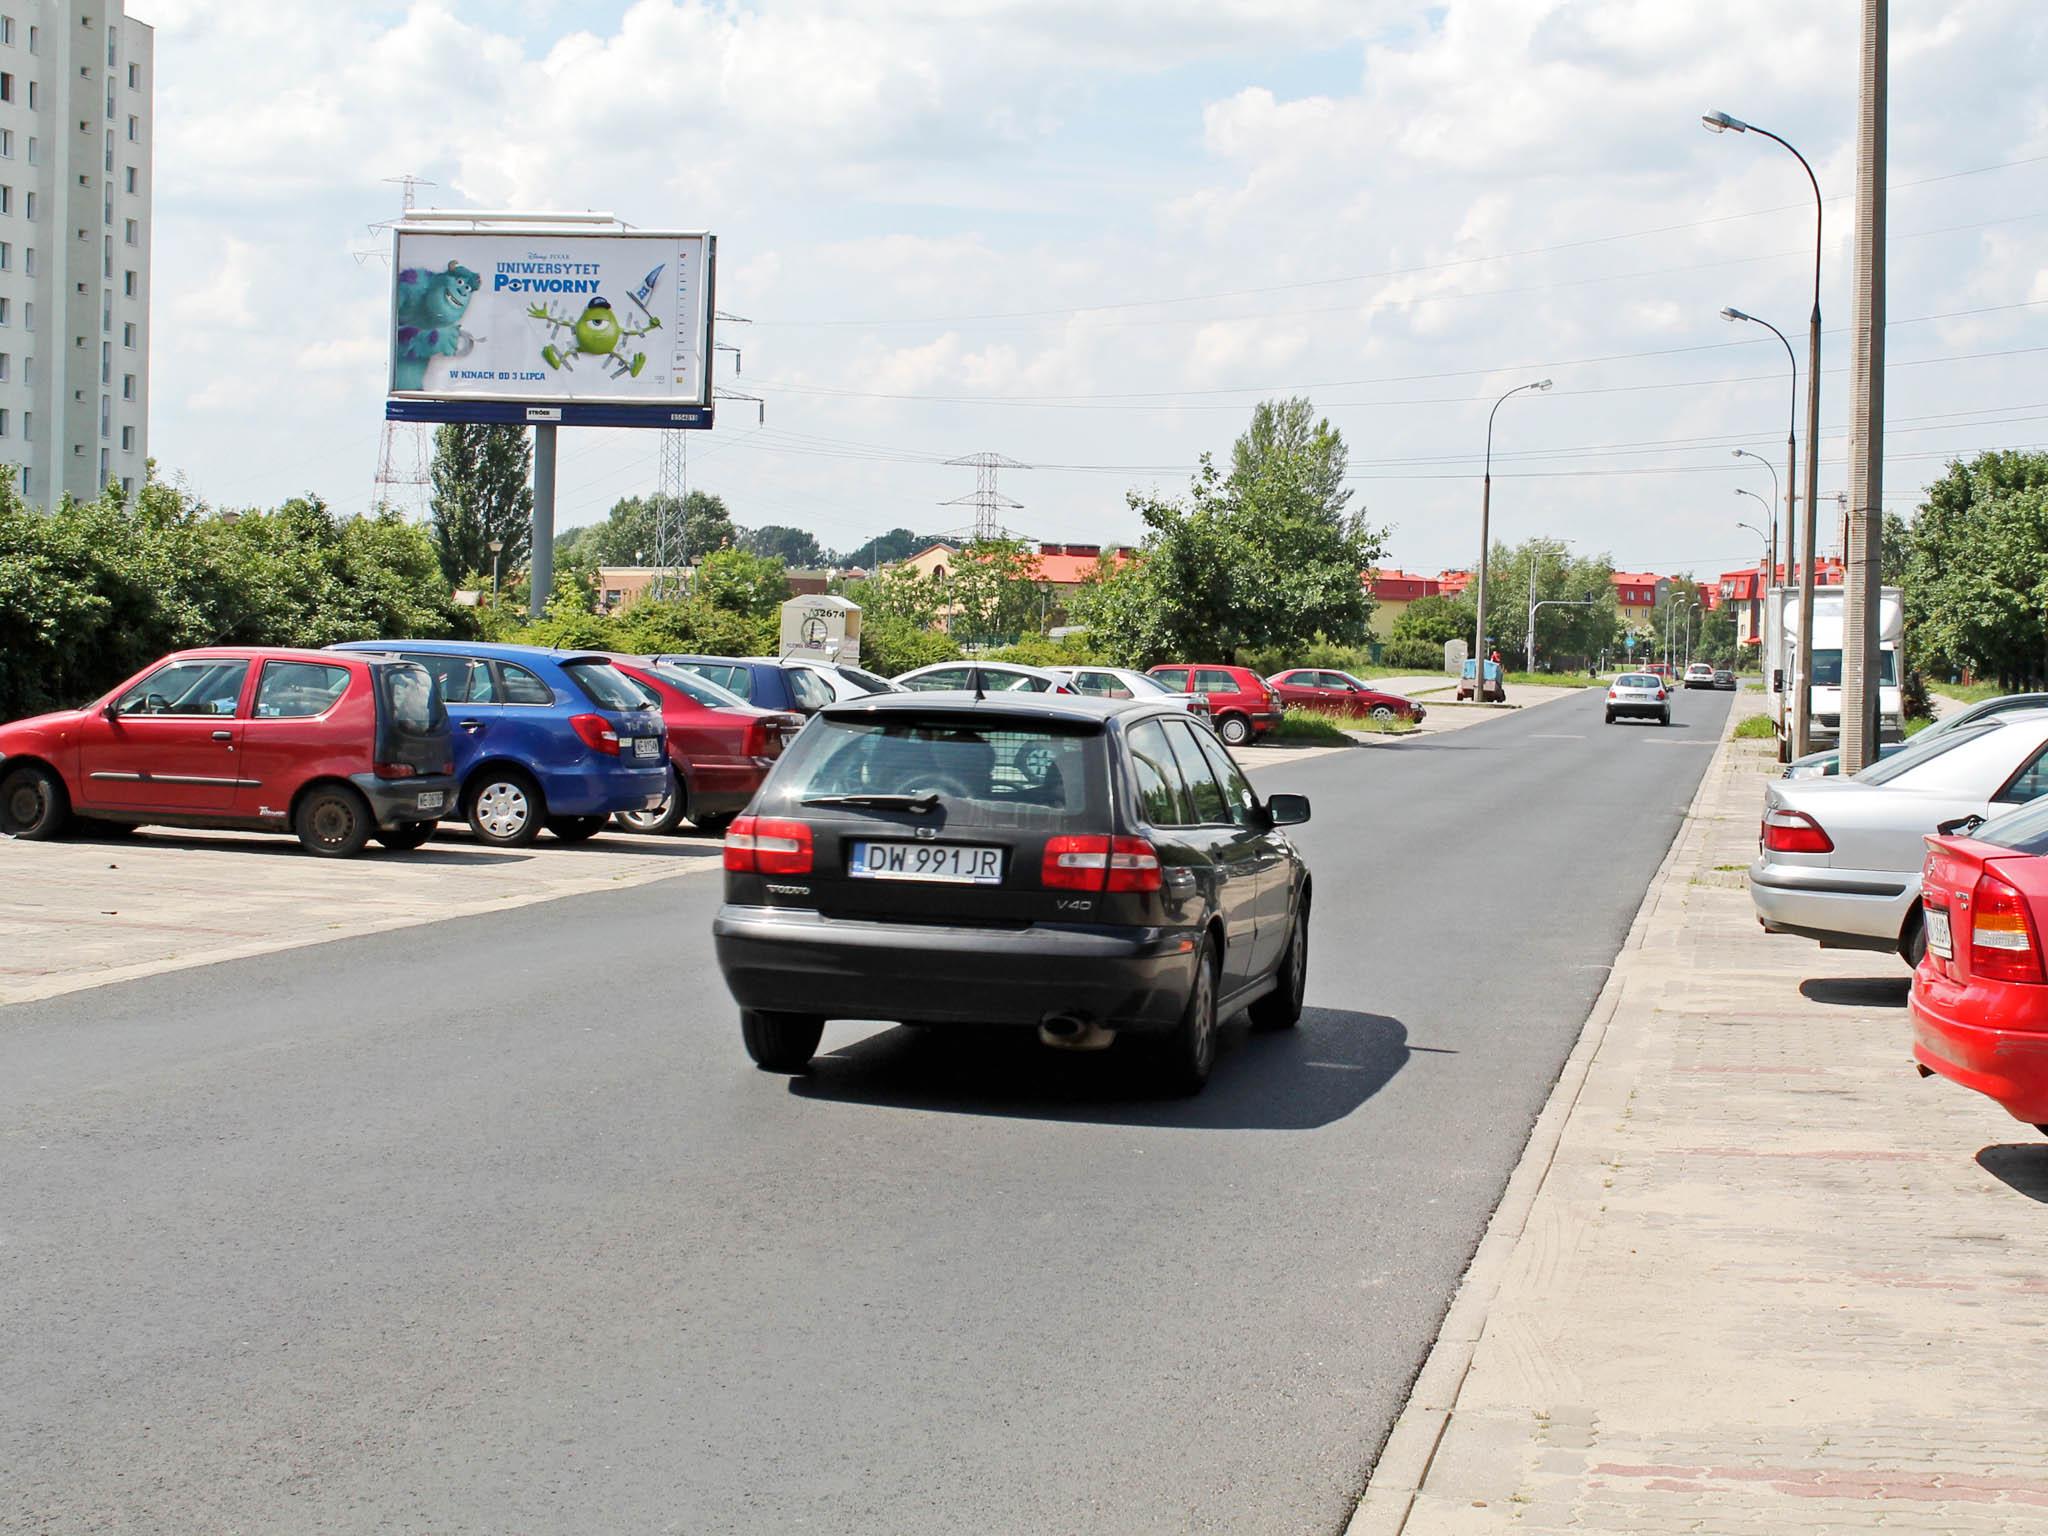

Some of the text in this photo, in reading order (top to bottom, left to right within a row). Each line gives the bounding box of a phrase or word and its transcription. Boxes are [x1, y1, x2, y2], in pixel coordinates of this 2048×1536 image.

[496, 262, 601, 275] UNIWERSYTET
[494, 273, 601, 293] POTWORNY
[449, 371, 546, 381] W KINACH OD 3 LIPCA
[869, 846, 998, 876] DW 991JR
[766, 884, 810, 895] VOLVO
[1056, 900, 1092, 910] V40
